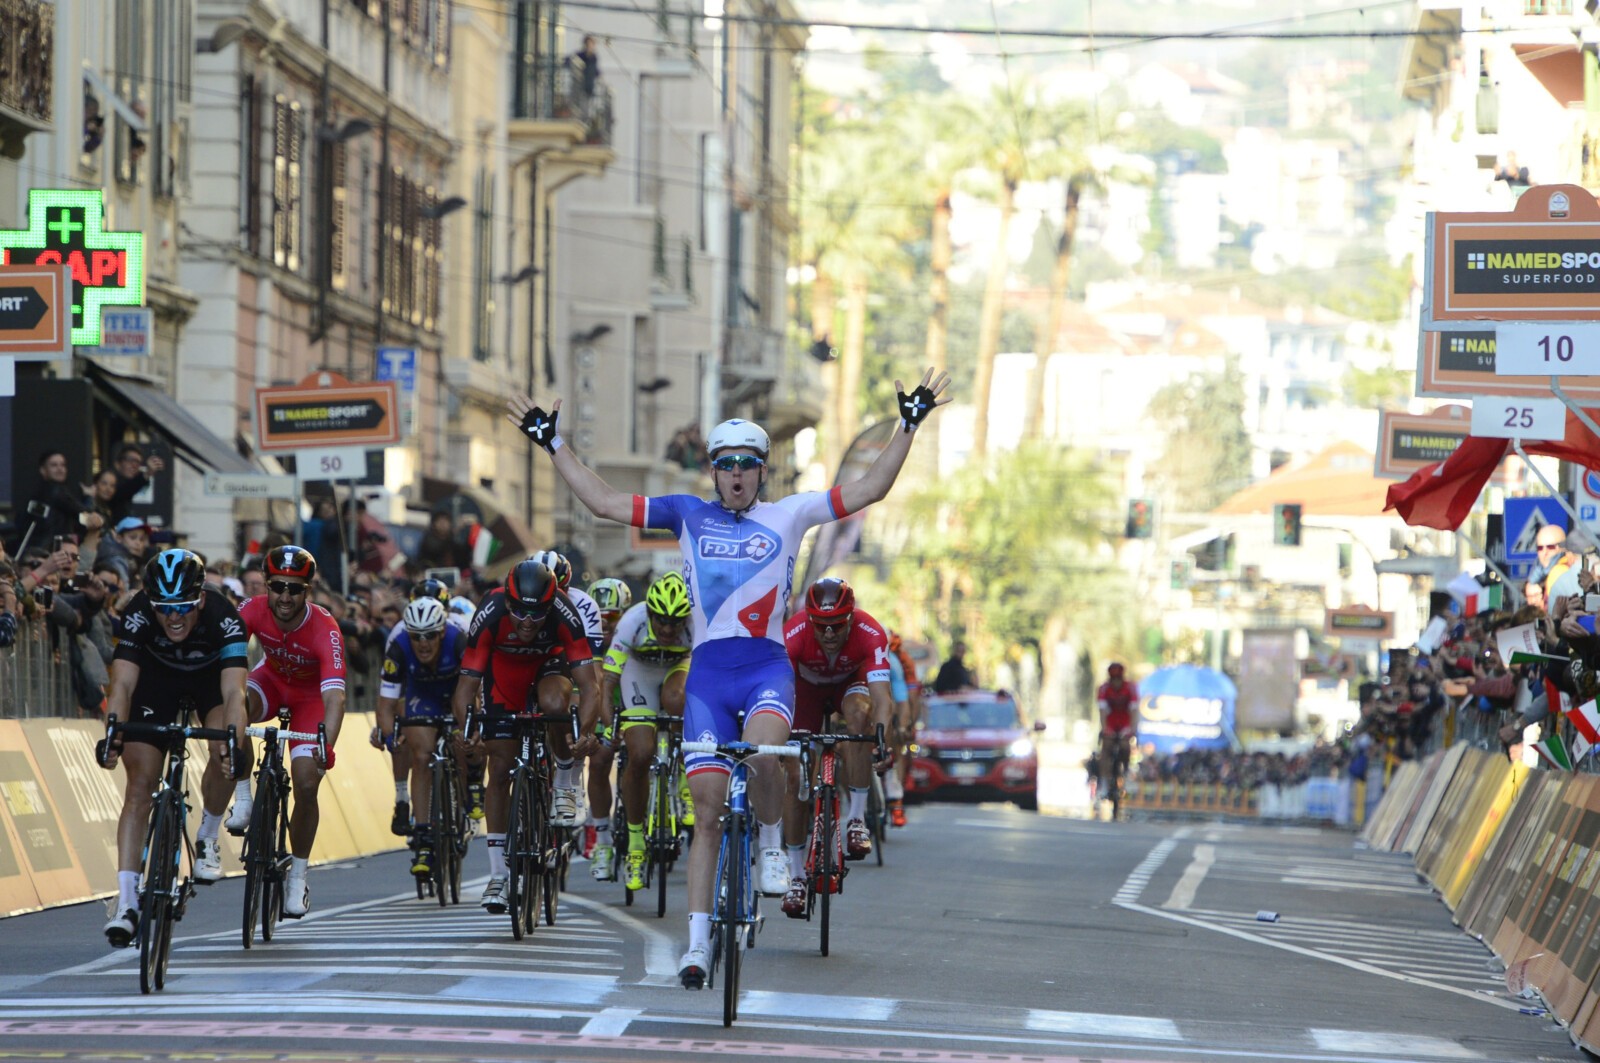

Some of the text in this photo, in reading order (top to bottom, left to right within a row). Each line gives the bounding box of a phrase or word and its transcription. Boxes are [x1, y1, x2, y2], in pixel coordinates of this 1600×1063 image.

[1487, 253, 1600, 269] NAMEDSPO
[1503, 274, 1595, 284] SUPERFOOD
[0, 297, 22, 311] RT
[1466, 338, 1496, 353] NAM
[1537, 335, 1574, 362] 10
[285, 405, 368, 421] NAMEDSPORT
[1503, 407, 1534, 428] 25
[320, 456, 342, 472] 50
[703, 541, 740, 556] FDJ
[469, 601, 496, 637] BMC
[553, 597, 581, 628] BMC
[576, 598, 600, 629] IAM
[522, 736, 530, 760] BMC
